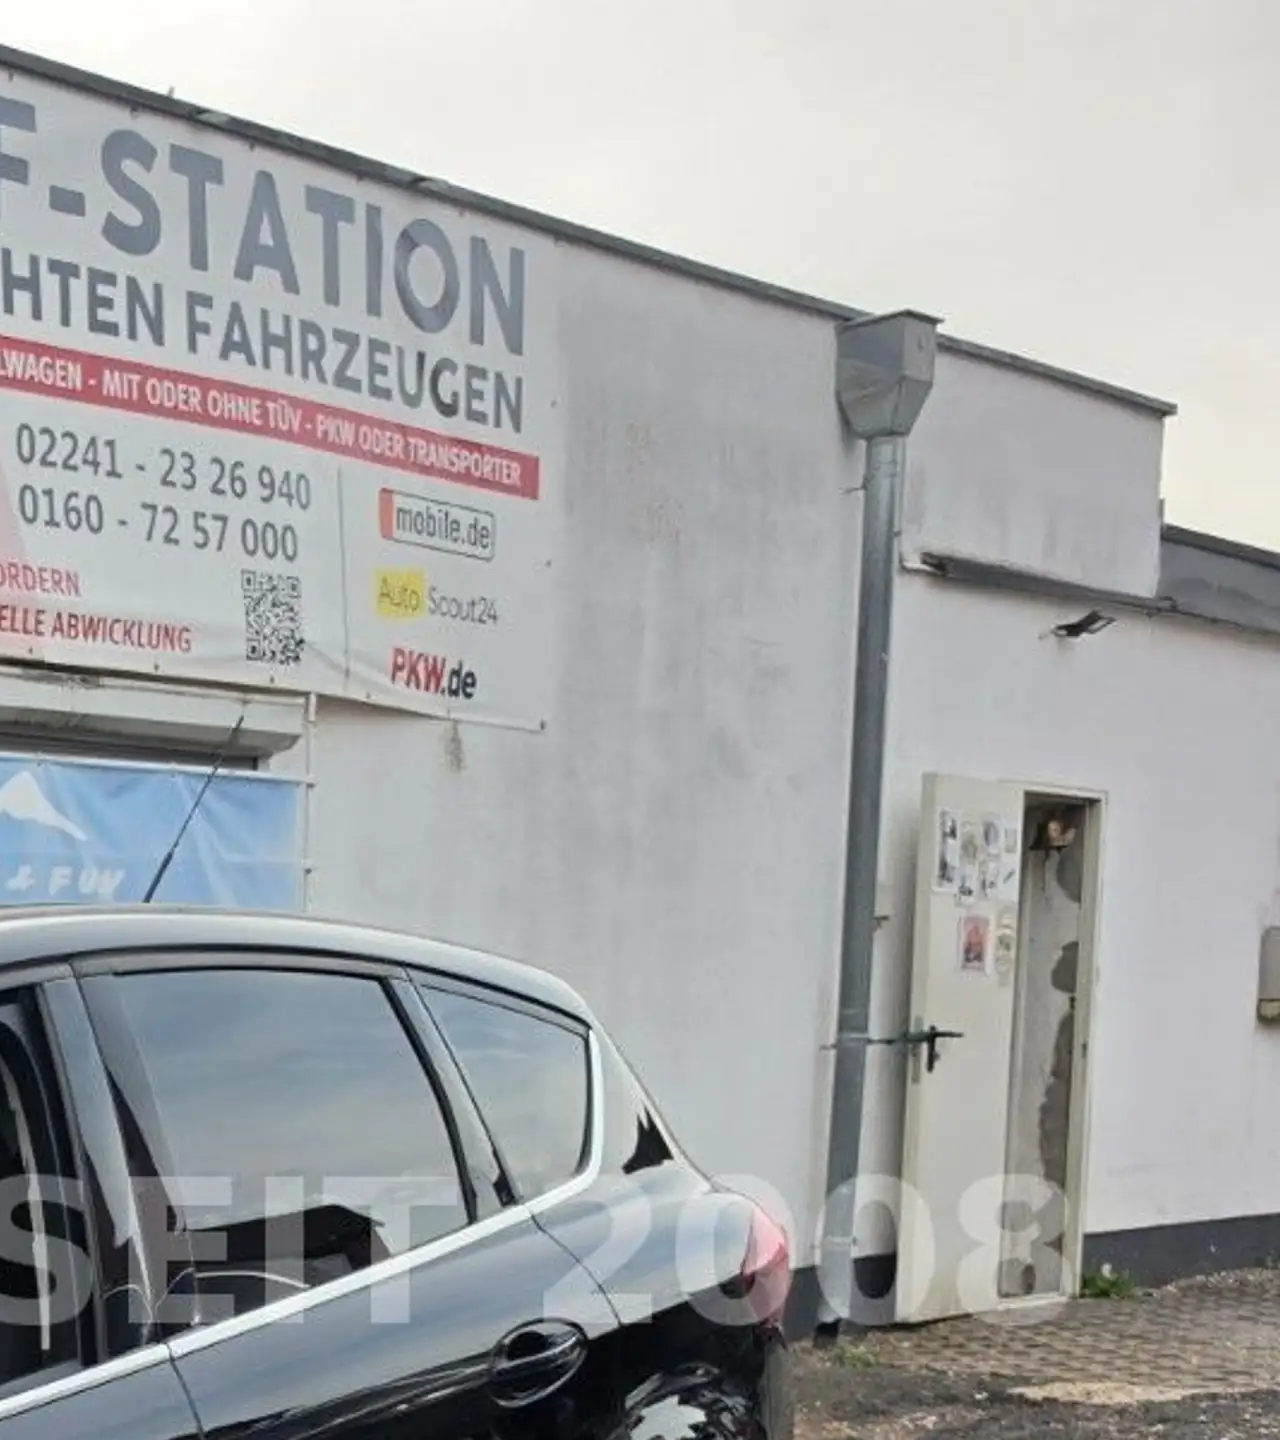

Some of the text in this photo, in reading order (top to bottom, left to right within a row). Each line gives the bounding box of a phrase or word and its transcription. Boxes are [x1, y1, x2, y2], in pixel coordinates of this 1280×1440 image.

[186, 290, 524, 434] FAHRZEUGEN
[101, 368, 142, 400] MIT
[145, 377, 203, 414] ODER
[207, 389, 262, 427] OHNE
[266, 400, 303, 435] TÜV
[315, 413, 355, 448] PKW
[359, 427, 405, 461] ODER
[408, 441, 522, 487] TRANSPORTER
[16, 423, 123, 479] 02241
[159, 448, 197, 490] 23
[209, 456, 247, 499] 26
[258, 464, 311, 512] 940
[18, 484, 104, 534] 0160
[141, 502, 180, 546] 72
[192, 511, 229, 552] 57
[240, 518, 298, 563] 000
[396, 504, 491, 551] mobile.de
[51, 611, 193, 653] ABWICKLUNG
[391, 647, 477, 699] PKW.de
[4, 864, 35, 891] &
